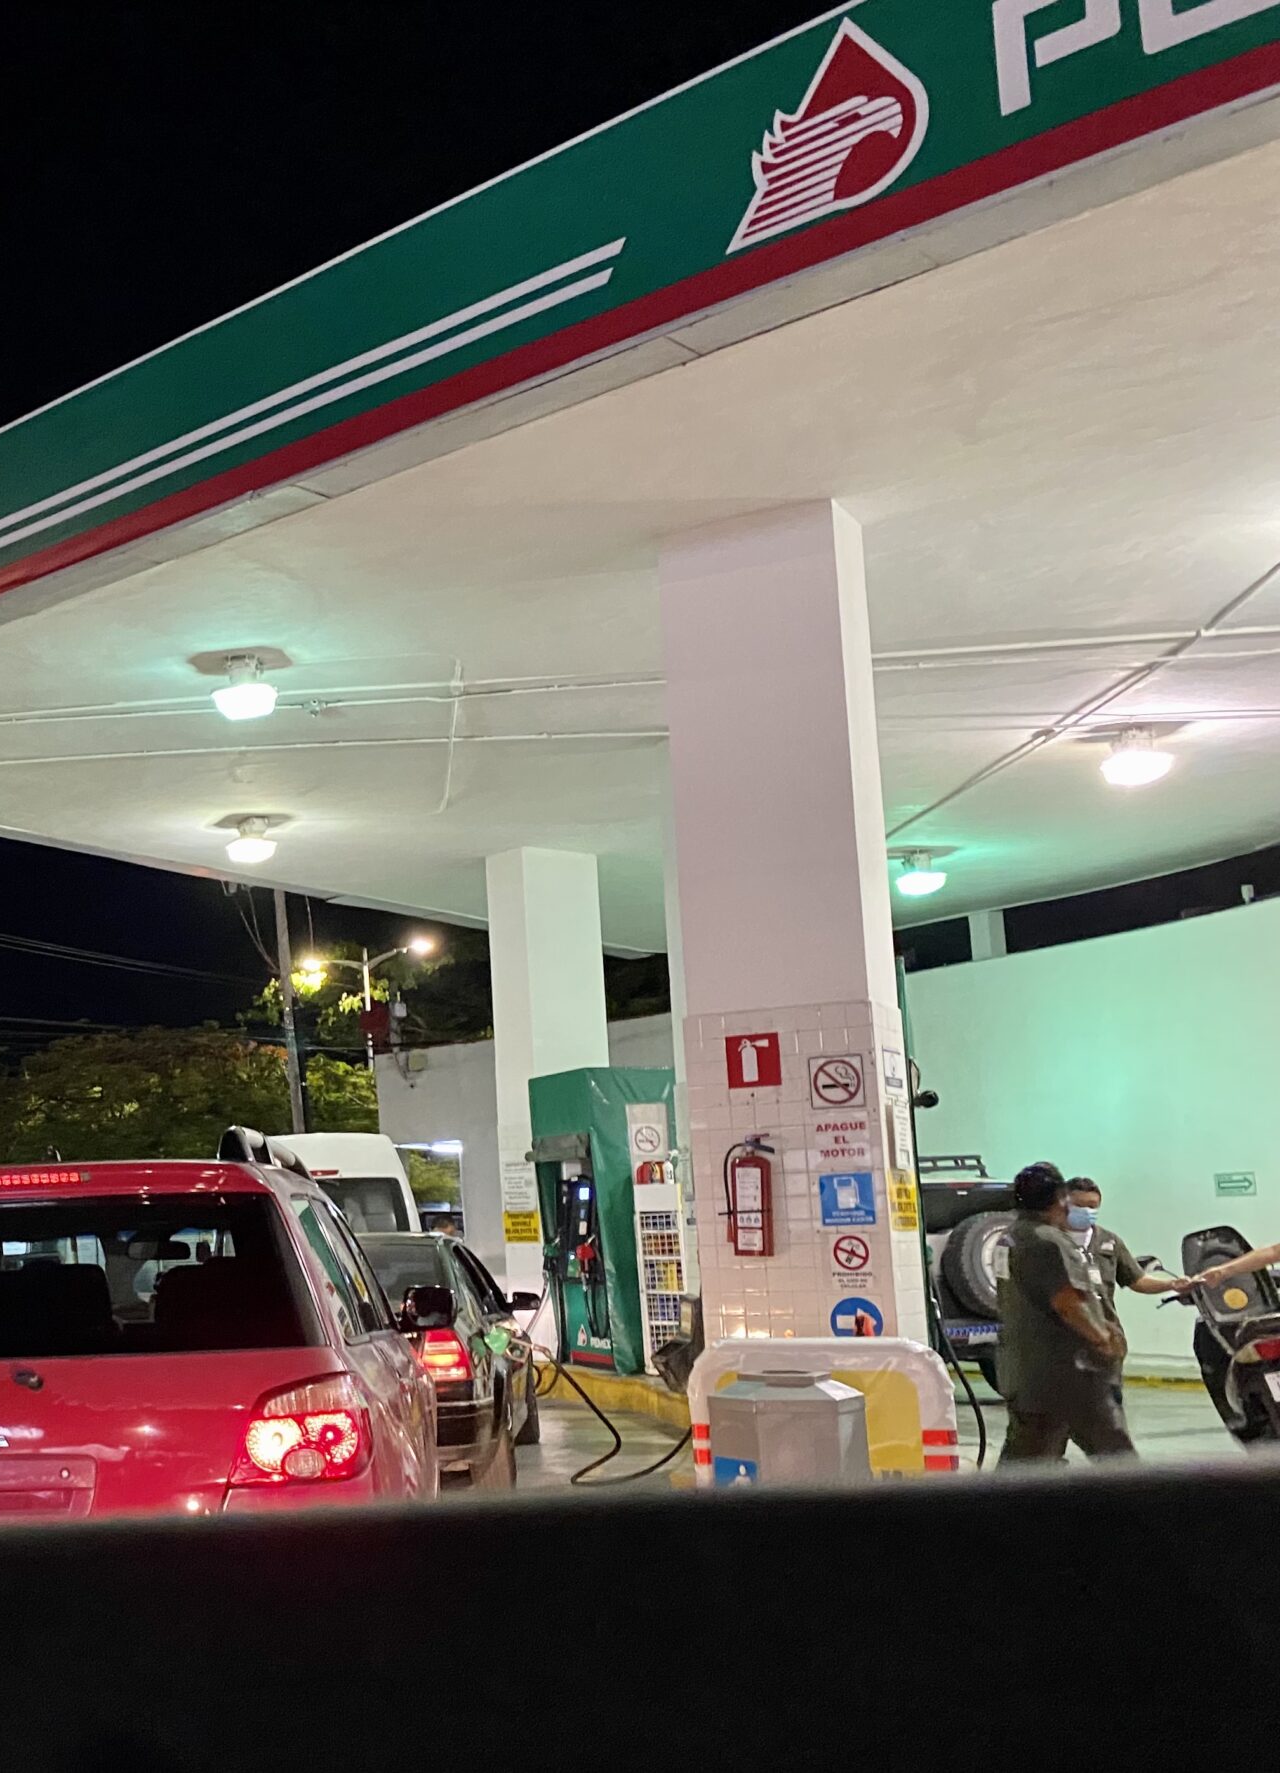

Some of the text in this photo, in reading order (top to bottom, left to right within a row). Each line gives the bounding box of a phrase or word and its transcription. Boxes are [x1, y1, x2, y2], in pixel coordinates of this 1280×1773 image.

[816, 1122, 866, 1133] APAGUE
[834, 1135, 849, 1145] EL
[820, 1147, 865, 1158] MOTOR
